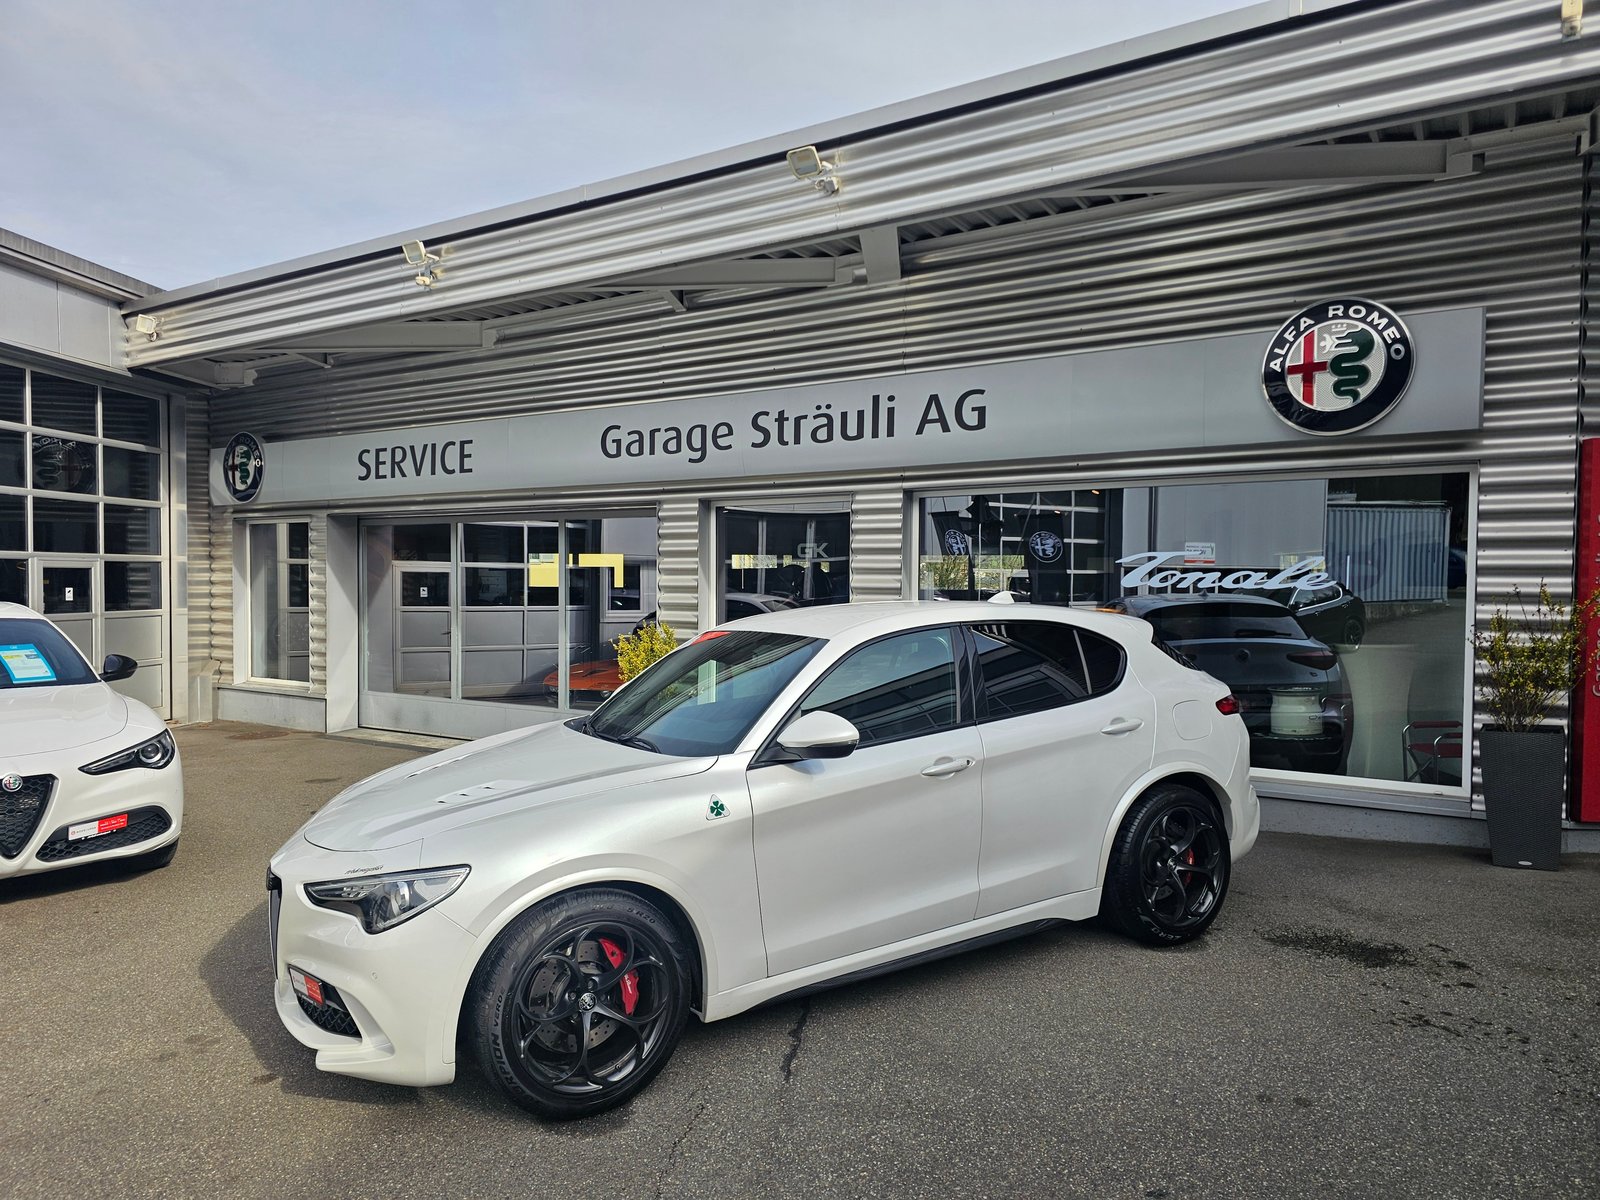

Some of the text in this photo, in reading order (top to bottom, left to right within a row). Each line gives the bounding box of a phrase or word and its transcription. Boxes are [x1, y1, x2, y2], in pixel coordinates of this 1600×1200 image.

[1269, 304, 1406, 373] ALFA ROMEO
[600, 388, 987, 464] Garage Sträuli AG
[357, 439, 474, 481] SERVICE
[1114, 551, 1338, 591] Tonale
